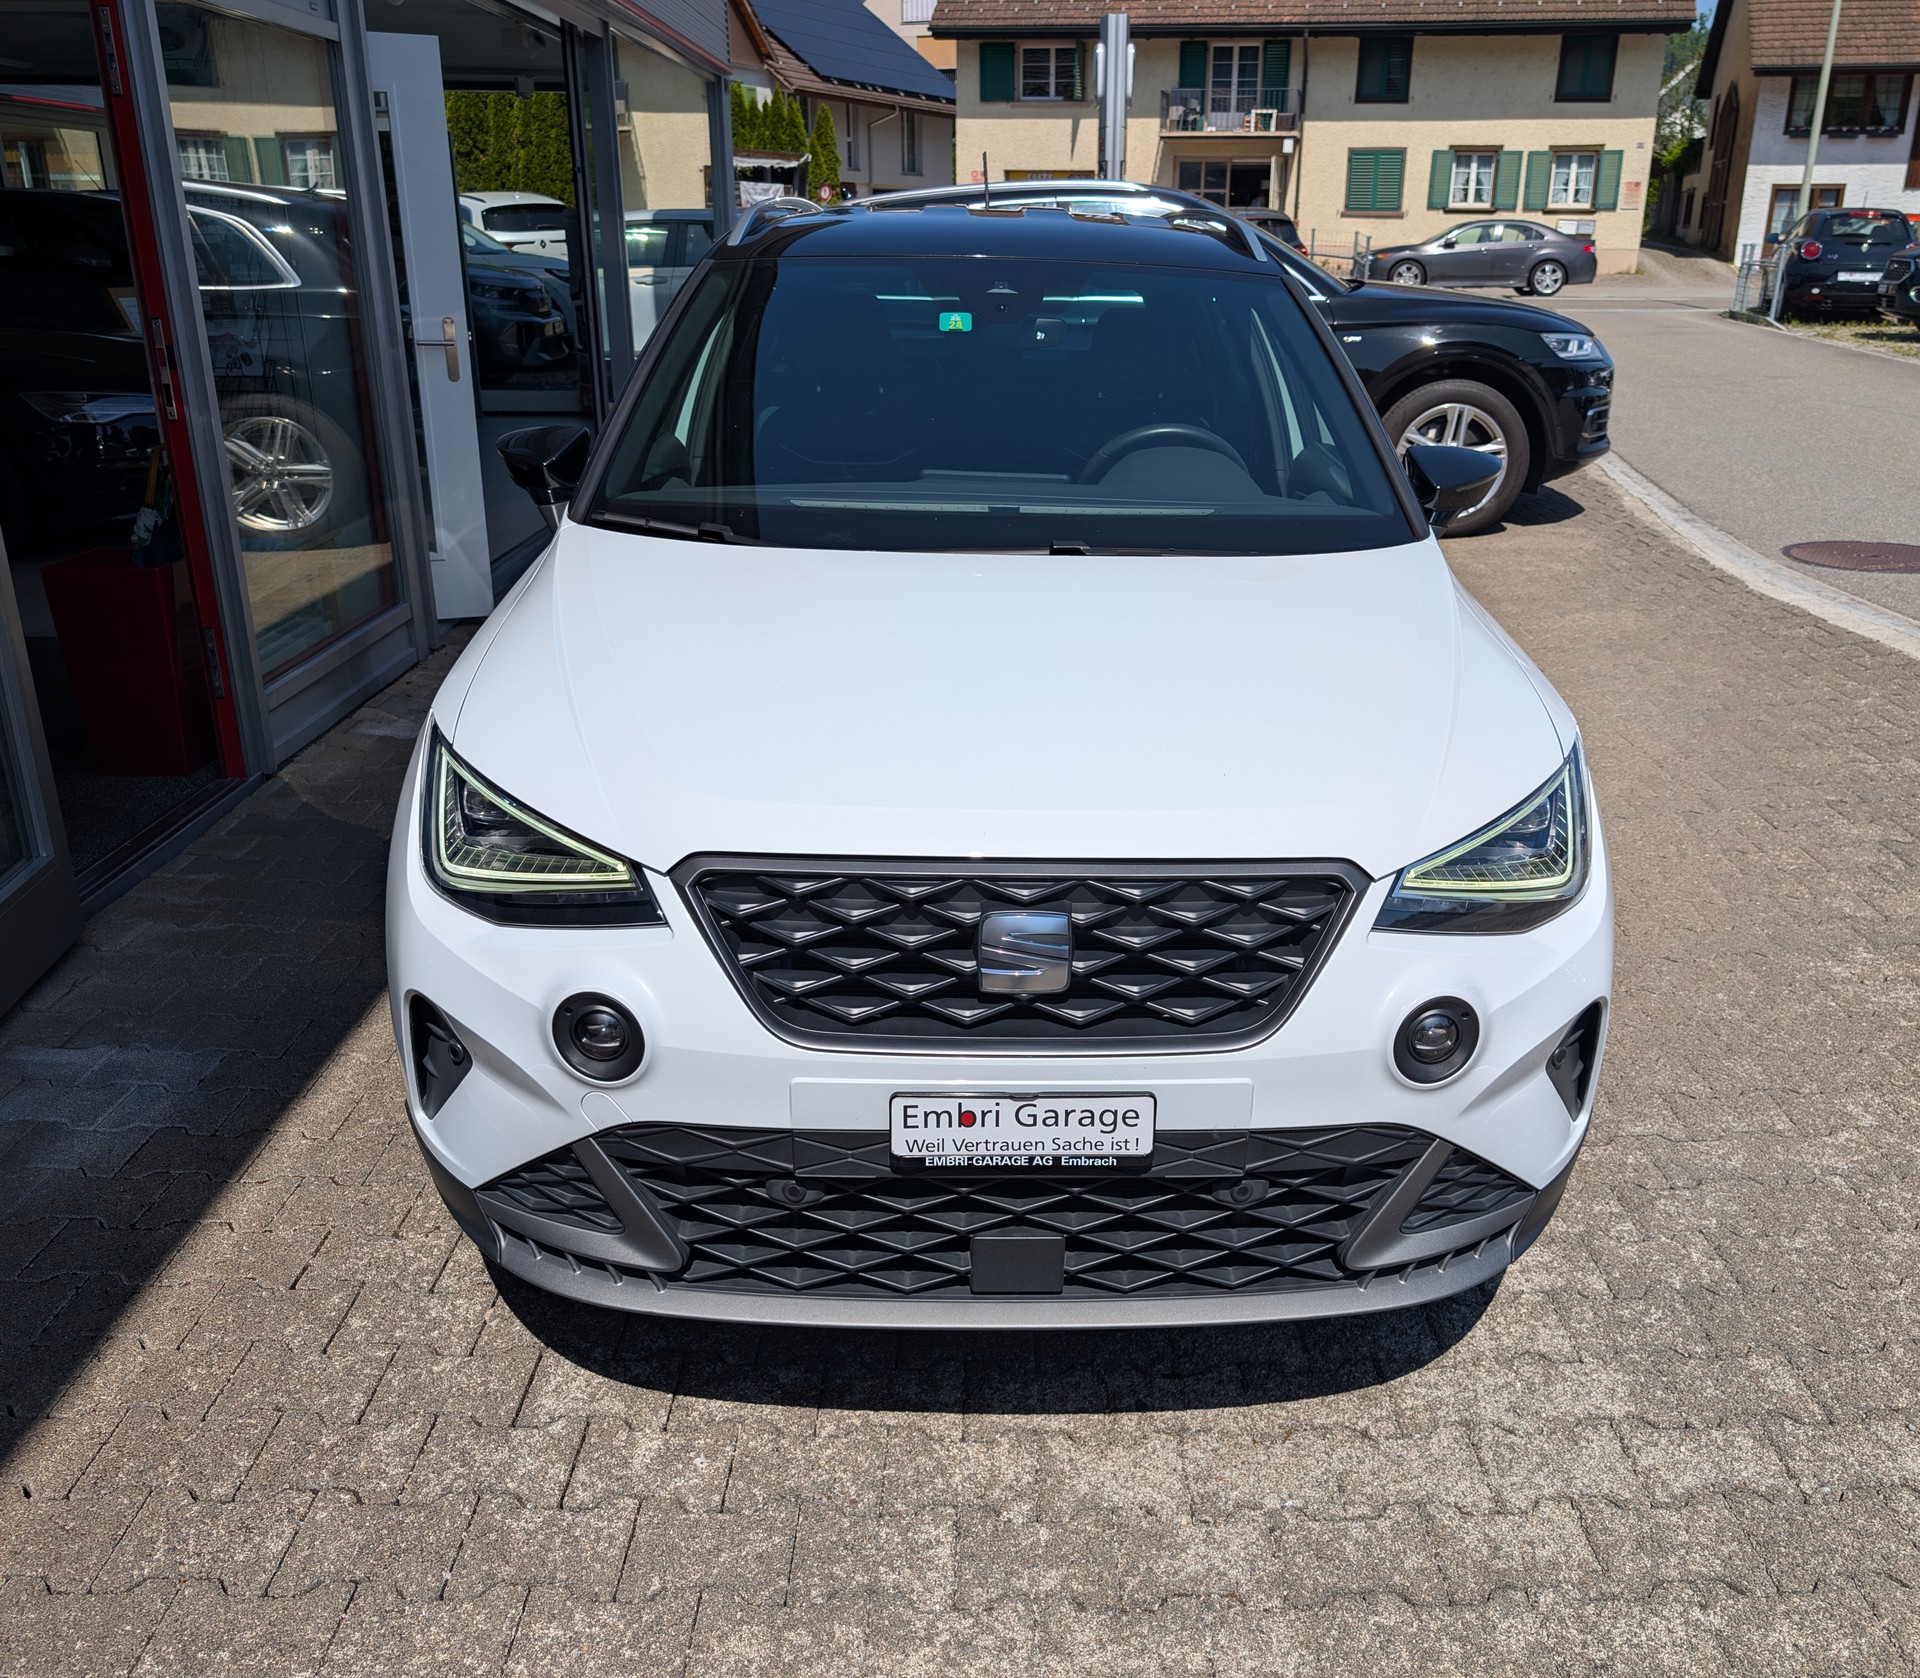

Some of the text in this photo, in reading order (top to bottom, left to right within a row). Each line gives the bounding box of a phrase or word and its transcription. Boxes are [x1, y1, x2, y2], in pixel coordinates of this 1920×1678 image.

[903, 1102, 1140, 1134] Embri Garage
[905, 1138, 945, 1153] Weil
[952, 1138, 1045, 1152] Vertrauen
[1051, 1137, 1105, 1151] Sache
[925, 1156, 1117, 1167] EMBRI-GARAGE AG Embrach
